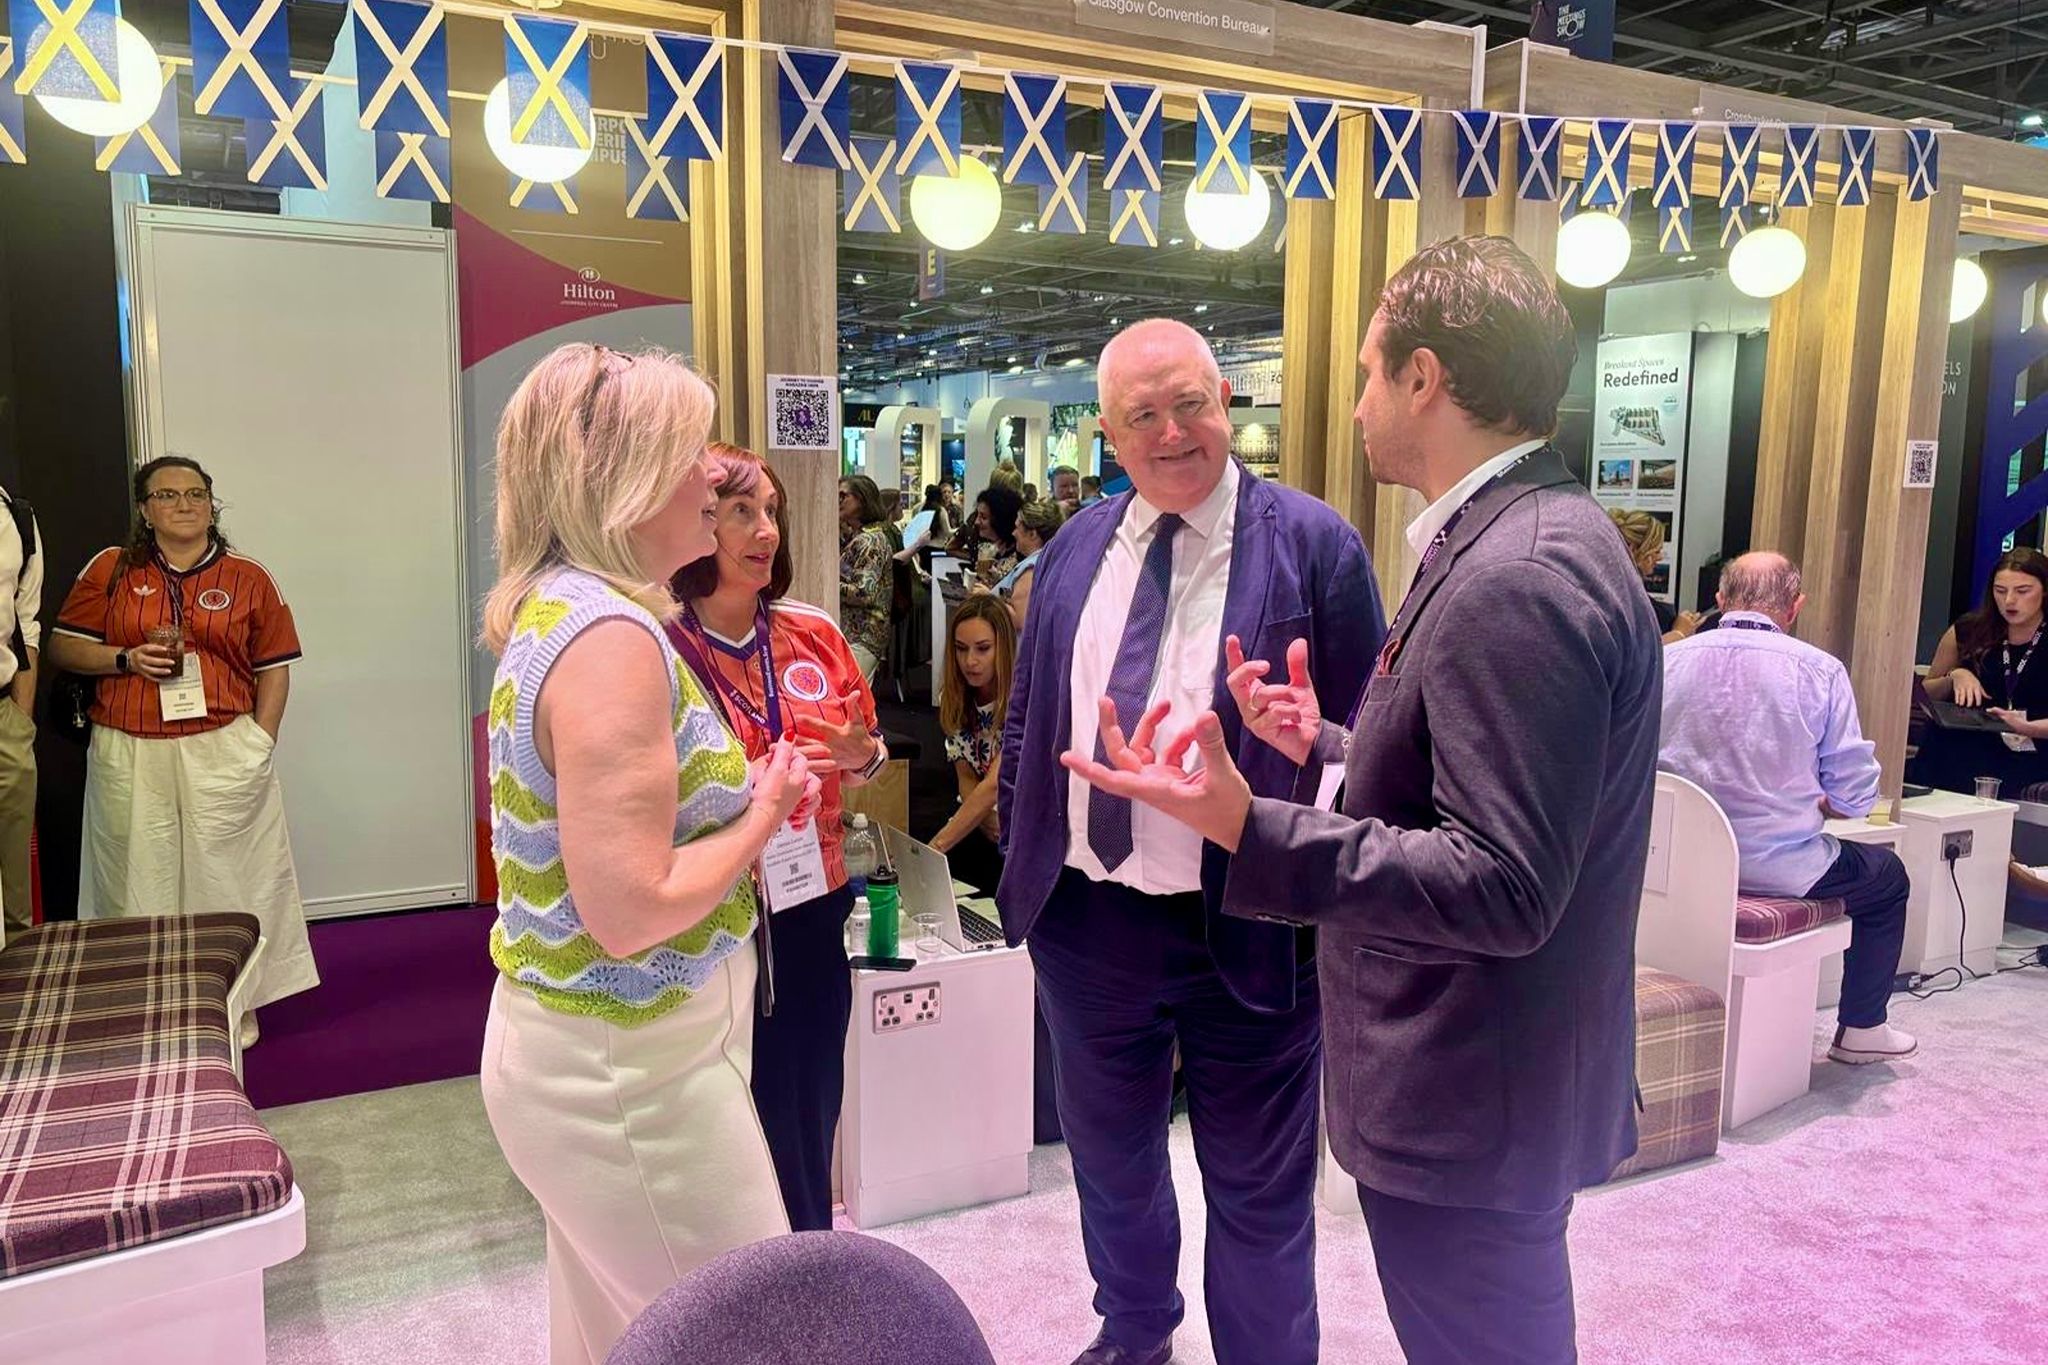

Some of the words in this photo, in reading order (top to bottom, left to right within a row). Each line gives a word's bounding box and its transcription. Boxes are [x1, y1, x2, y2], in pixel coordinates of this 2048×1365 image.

[1148, 4, 1218, 28] Convention
[563, 283, 615, 300] Hilton
[1603, 367, 1679, 388] Redefined
